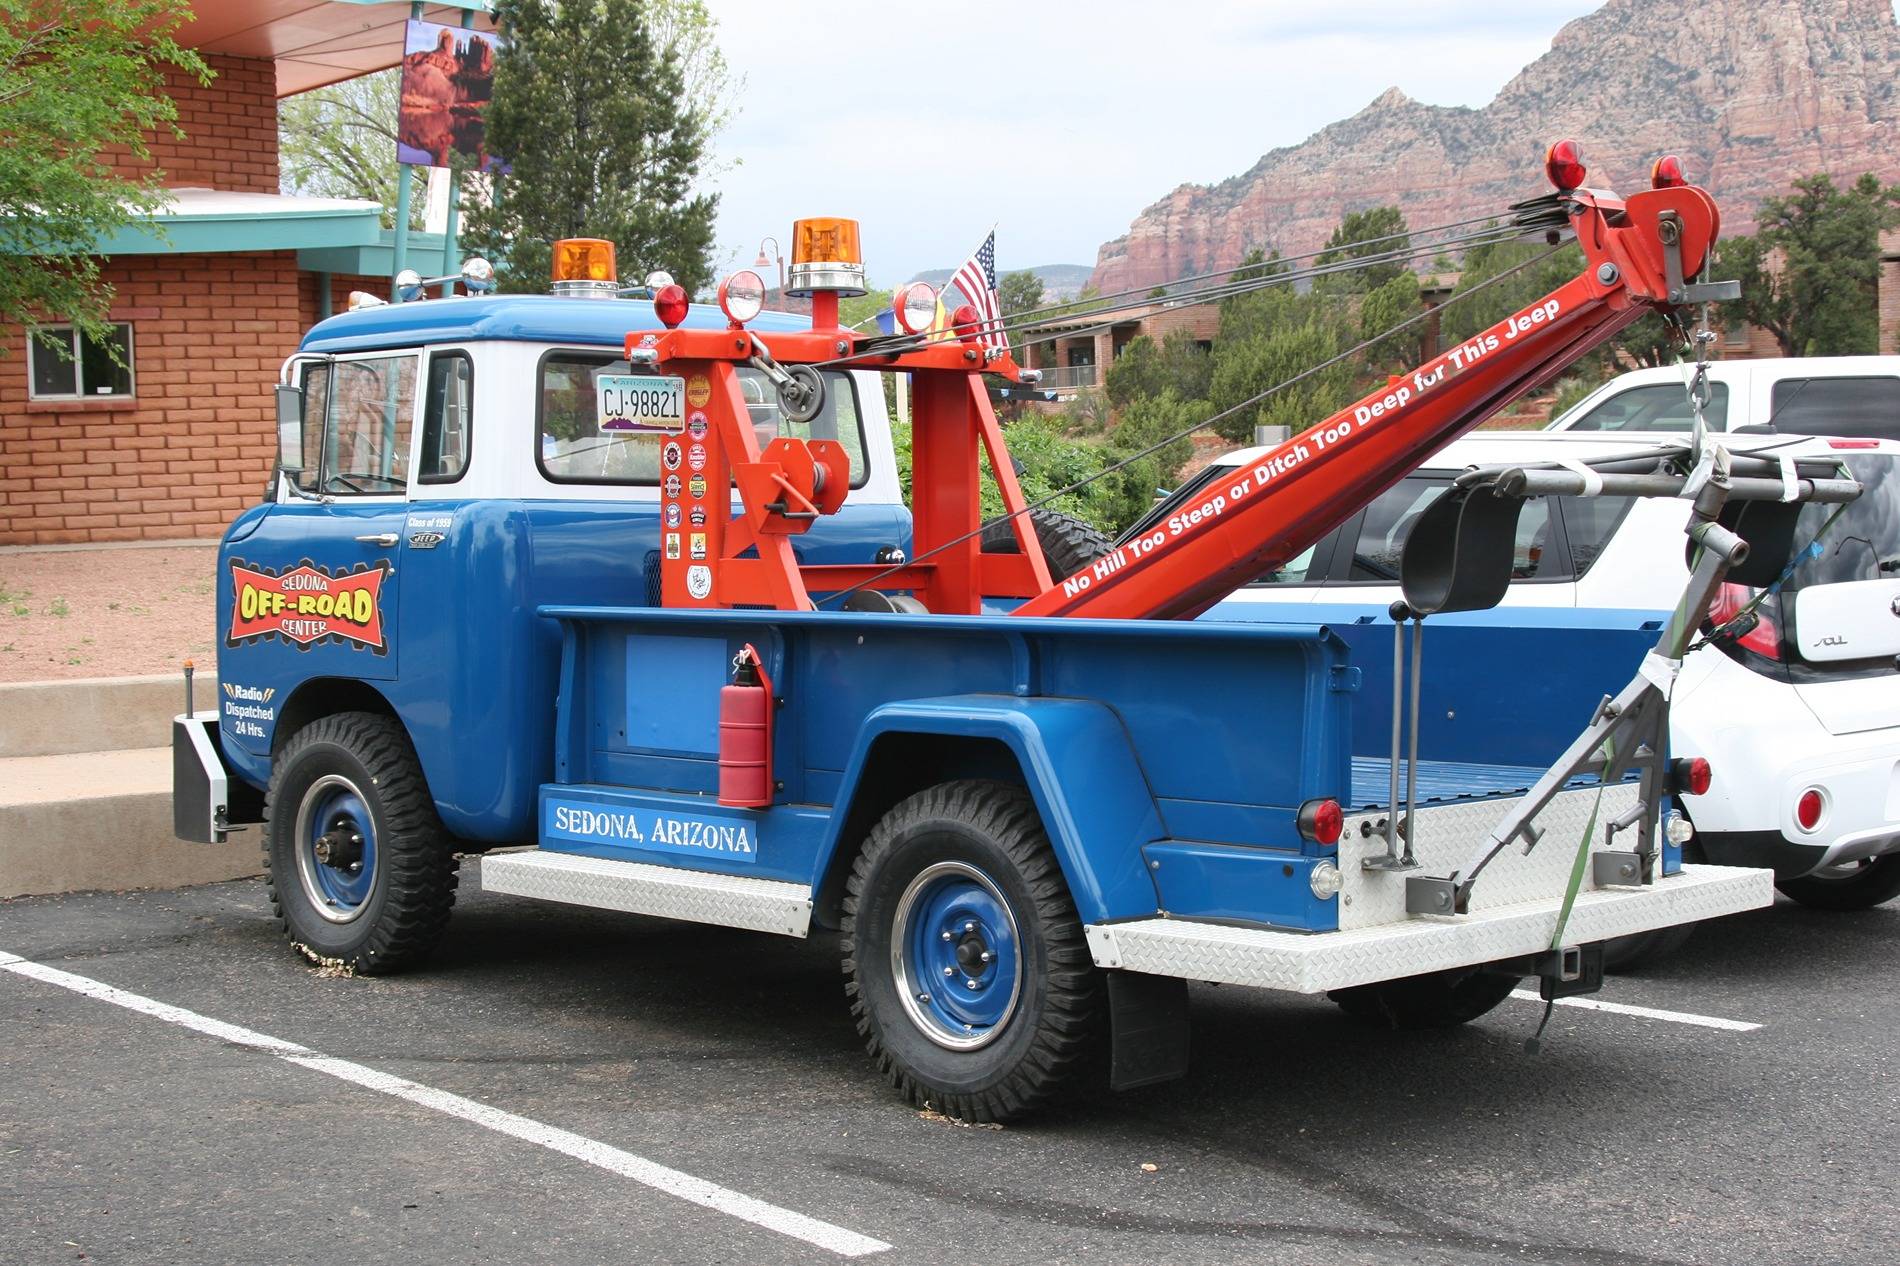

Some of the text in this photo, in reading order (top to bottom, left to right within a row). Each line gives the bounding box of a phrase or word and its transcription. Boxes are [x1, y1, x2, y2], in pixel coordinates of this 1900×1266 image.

[620, 380, 664, 388] ARIZONA
[1063, 299, 1560, 598] No Hill Too Steep or Ditch Too Deep for This Jeep
[408, 517, 426, 528] Class
[427, 517, 436, 528] of
[414, 535, 436, 543] JEEP
[281, 574, 328, 592] SEDONA
[240, 583, 374, 625] OFF-ROAD
[281, 618, 328, 637] CENTER
[234, 685, 263, 702] Radio
[225, 701, 274, 721] Dispatched
[235, 720, 266, 738] 24 Hrs.
[555, 806, 752, 853] SEDONA, ARIZONA
